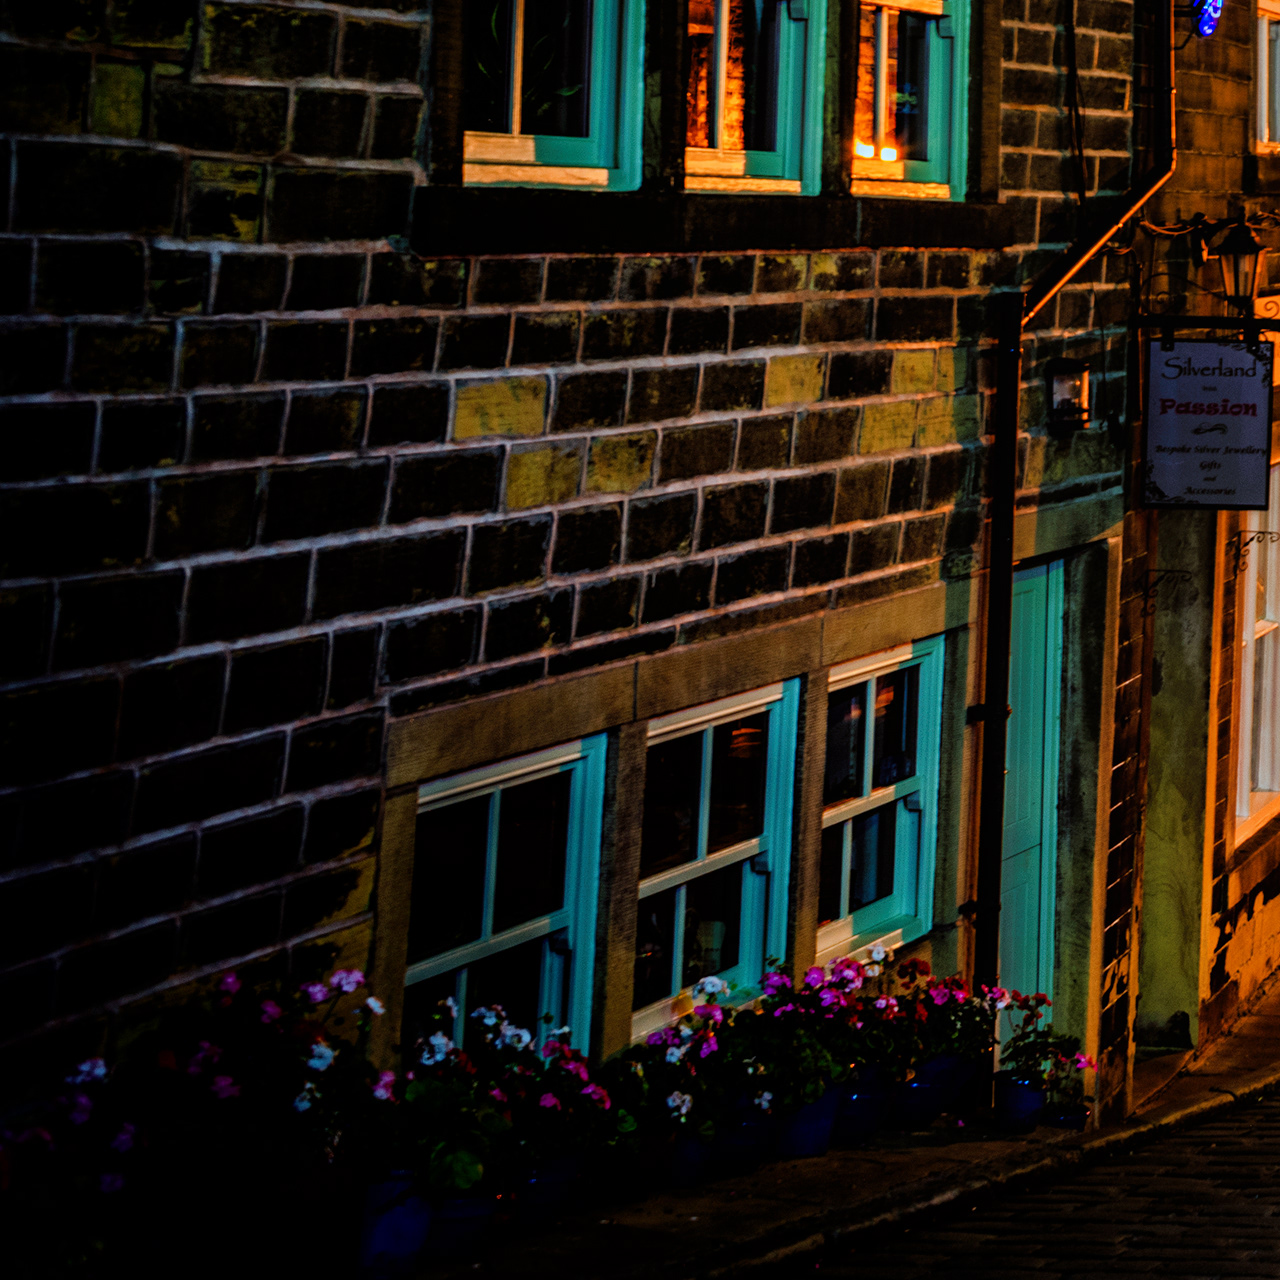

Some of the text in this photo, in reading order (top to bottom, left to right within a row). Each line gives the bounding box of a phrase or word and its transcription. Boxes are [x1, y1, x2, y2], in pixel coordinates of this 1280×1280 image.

[1161, 356, 1257, 379] Silverland
[1159, 398, 1258, 416] Passion
[1155, 445, 1268, 457] Bespoke Silver Jewellery
[1200, 460, 1221, 471] Gifts
[1183, 486, 1237, 496] Accessories
